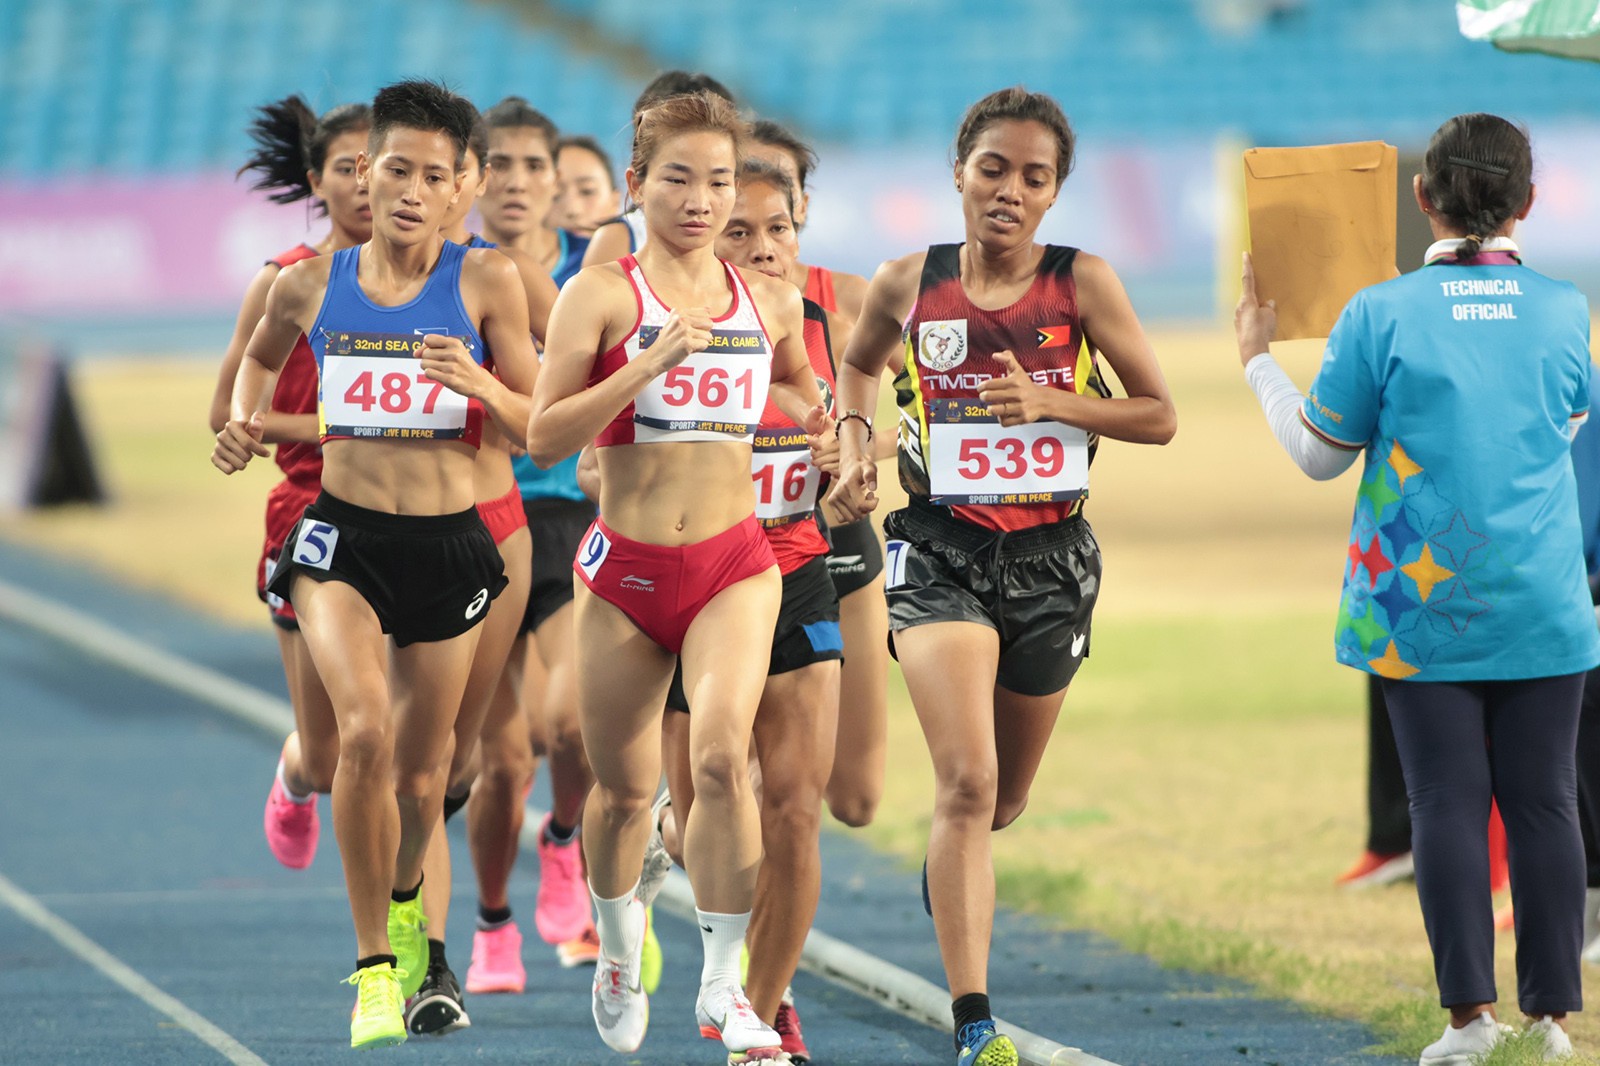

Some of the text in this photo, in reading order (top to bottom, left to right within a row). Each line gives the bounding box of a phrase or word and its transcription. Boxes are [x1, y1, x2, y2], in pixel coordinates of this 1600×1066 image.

[1440, 279, 1523, 297] TECHNICAL
[1452, 303, 1517, 321] OFFICIAL
[354, 339, 382, 350] 32nd
[385, 340, 409, 351] SEA
[708, 336, 760, 348] SEA GAMES
[344, 371, 445, 414] 487
[661, 366, 753, 409] 561
[353, 426, 434, 439] SPORTS LIVE IN PEACE
[669, 421, 747, 433] SPORTS LIVE IN PEACE
[754, 434, 808, 447] SEA GAME
[957, 436, 1065, 480] 539
[752, 462, 808, 504] 16
[968, 492, 1053, 504] SPORTS LIVE IN PEACE
[299, 523, 334, 564] 5
[580, 531, 604, 567] 9
[828, 563, 866, 574] I-NING
[620, 581, 655, 592] LI-NING
